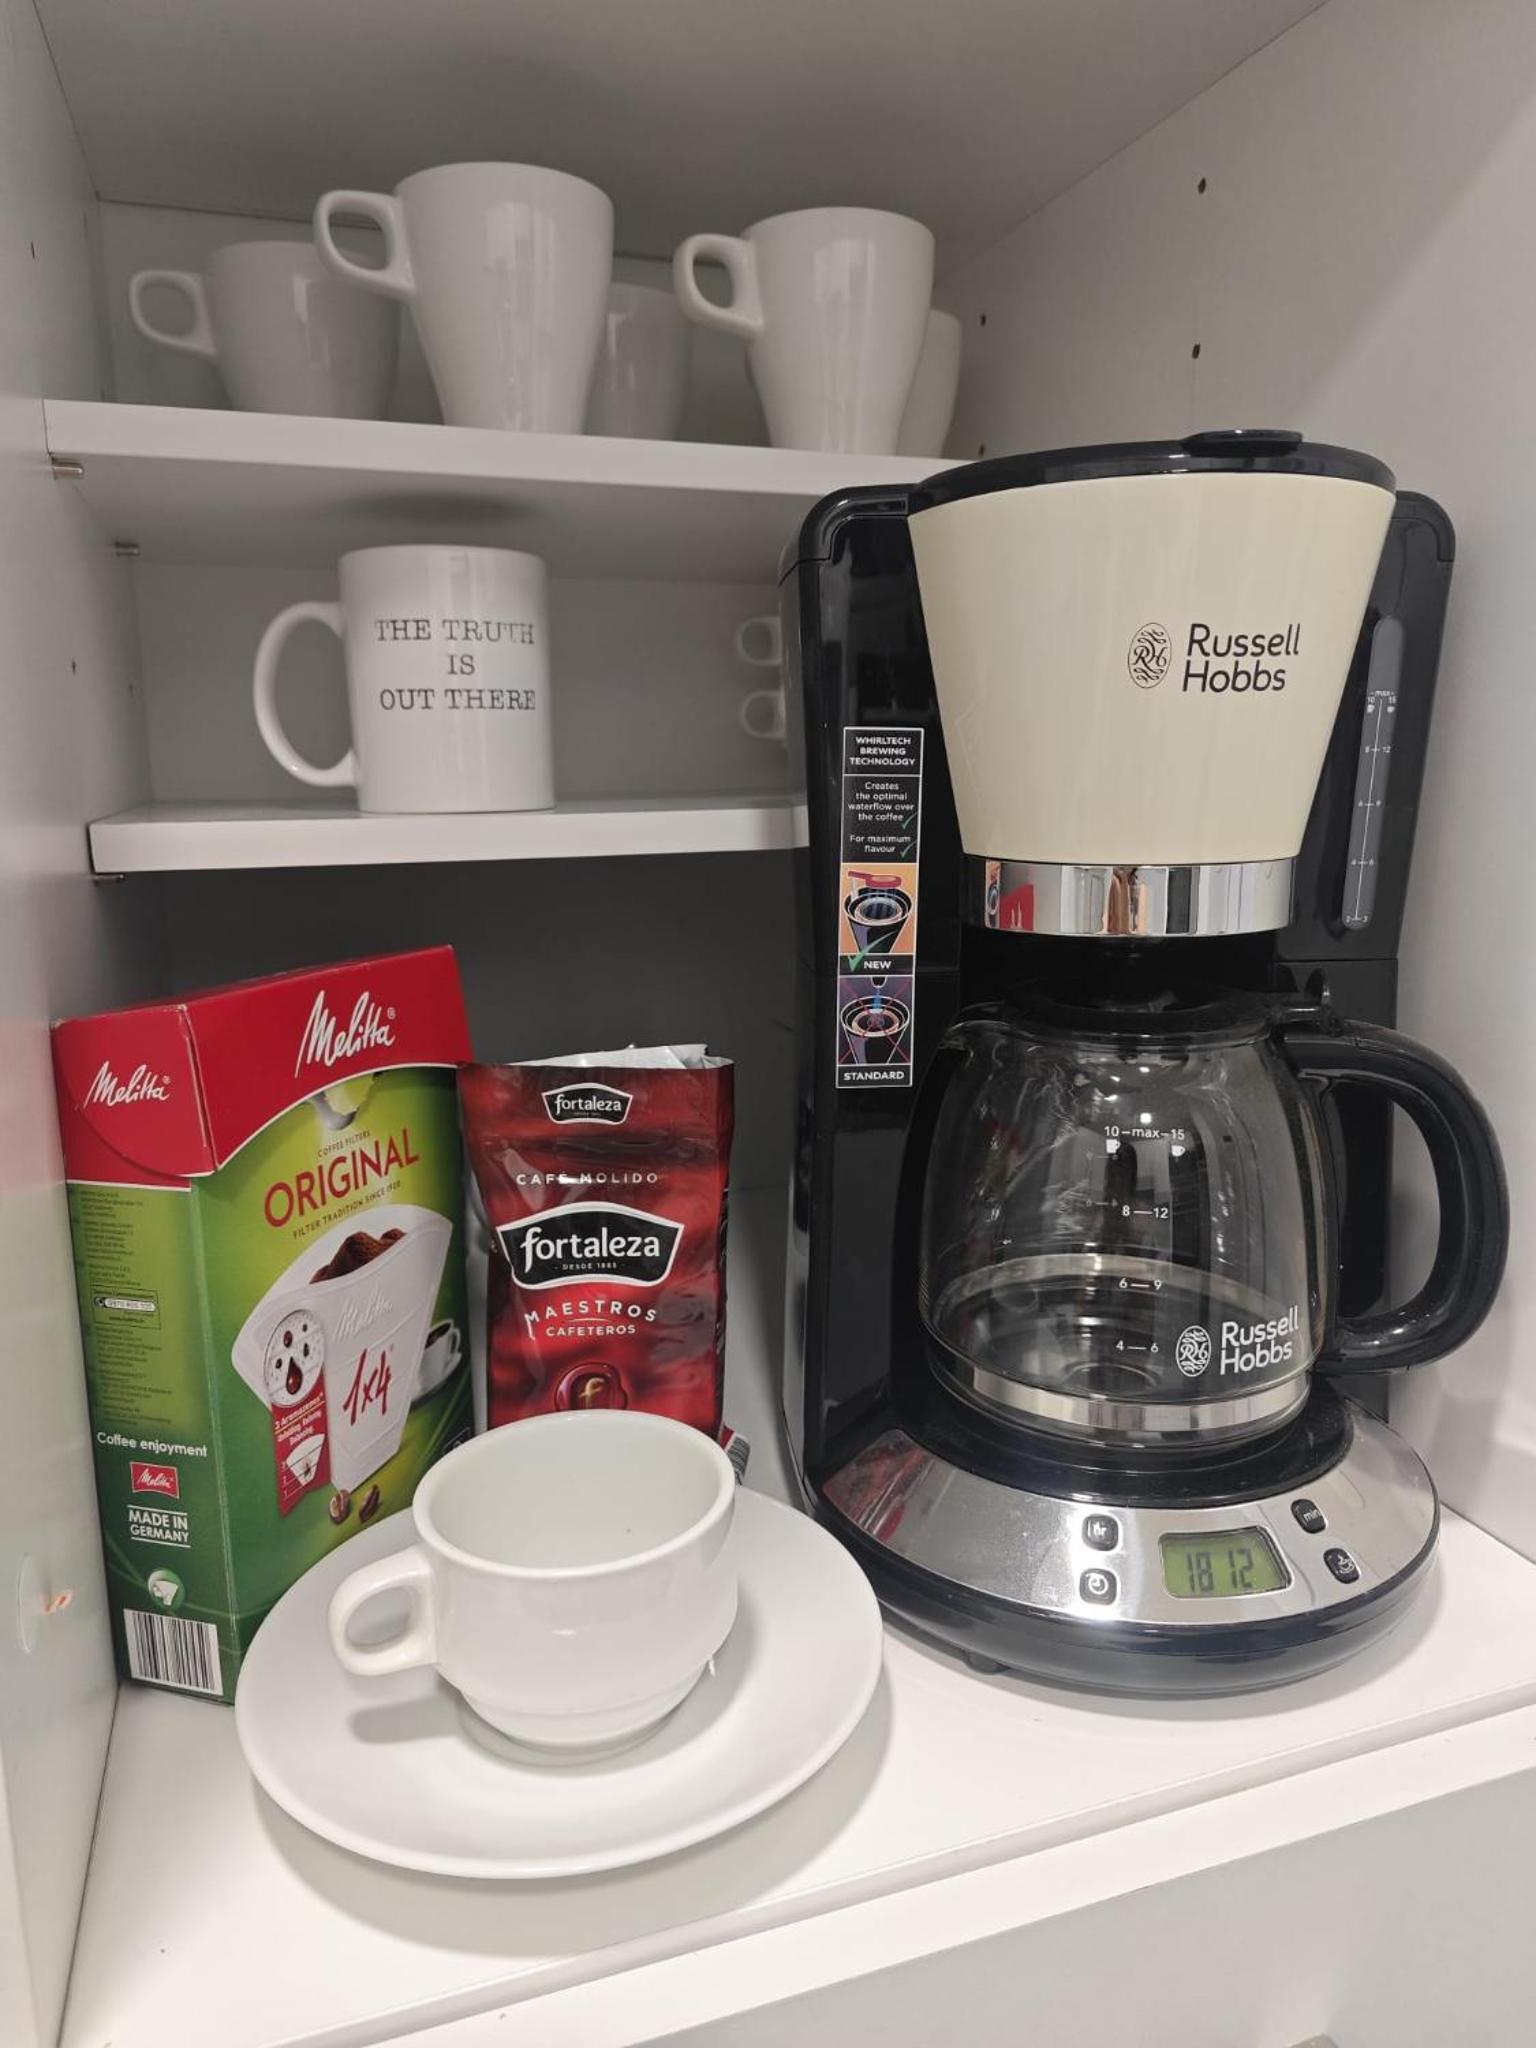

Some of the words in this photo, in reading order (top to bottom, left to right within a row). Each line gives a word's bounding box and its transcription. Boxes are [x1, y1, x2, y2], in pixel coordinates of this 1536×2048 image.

[375, 619, 431, 641] THE
[442, 619, 535, 645] TRUTH
[1187, 622, 1301, 657] Russell
[447, 653, 476, 676] IS
[1182, 659, 1287, 693] Hobbs
[379, 688, 436, 711] OUT
[444, 688, 536, 711] THERE
[855, 736, 911, 745] WHIRLTECH
[848, 756, 916, 766] TECHNOLOGY
[860, 747, 907, 756] BREWING
[864, 781, 900, 790] Creates
[847, 803, 893, 811] waterflow
[894, 803, 915, 811] over
[855, 792, 871, 800] the
[873, 792, 908, 802] optimal
[858, 813, 873, 821] the
[875, 813, 904, 821] coffee
[849, 835, 865, 843] For
[867, 835, 912, 843] maximum
[864, 845, 896, 853] flavour
[863, 960, 892, 969] NEW
[295, 989, 396, 1079] Melitta
[83, 1061, 171, 1110] Melitta
[843, 1071, 905, 1081] STANDARD
[554, 1094, 622, 1115] fortaleza
[1103, 1125, 1120, 1137] 10
[1131, 1129, 1160, 1138] max
[1170, 1128, 1185, 1140] 15
[317, 1138, 345, 1158] COFFEE
[345, 1129, 371, 1147] FILTERS
[264, 1128, 421, 1228] ORIGINAL
[580, 1172, 658, 1185] MOLIDO
[293, 1218, 321, 1240] FILTER
[322, 1199, 364, 1225] TRADITION
[364, 1188, 386, 1205] SINCE
[1122, 1205, 1131, 1217] 8
[1153, 1206, 1169, 1219] 12
[520, 1226, 661, 1274] fortaleza
[562, 1262, 593, 1271] DESDE
[1118, 1277, 1128, 1289] 6
[1154, 1279, 1163, 1290] 9
[524, 1299, 657, 1326] MAESTROS
[545, 1323, 637, 1337] CAFETEROS
[1221, 1305, 1300, 1348] Russell
[1116, 1339, 1124, 1350] 4
[1150, 1341, 1159, 1353] 6
[1219, 1339, 1293, 1375] Hobbs
[342, 1348, 391, 1426] 1x4
[96, 1431, 137, 1448] Coffee
[140, 1439, 208, 1457] enjoyment
[129, 1509, 170, 1528] MADE
[173, 1515, 188, 1531] IN
[130, 1523, 190, 1543] GERMANY
